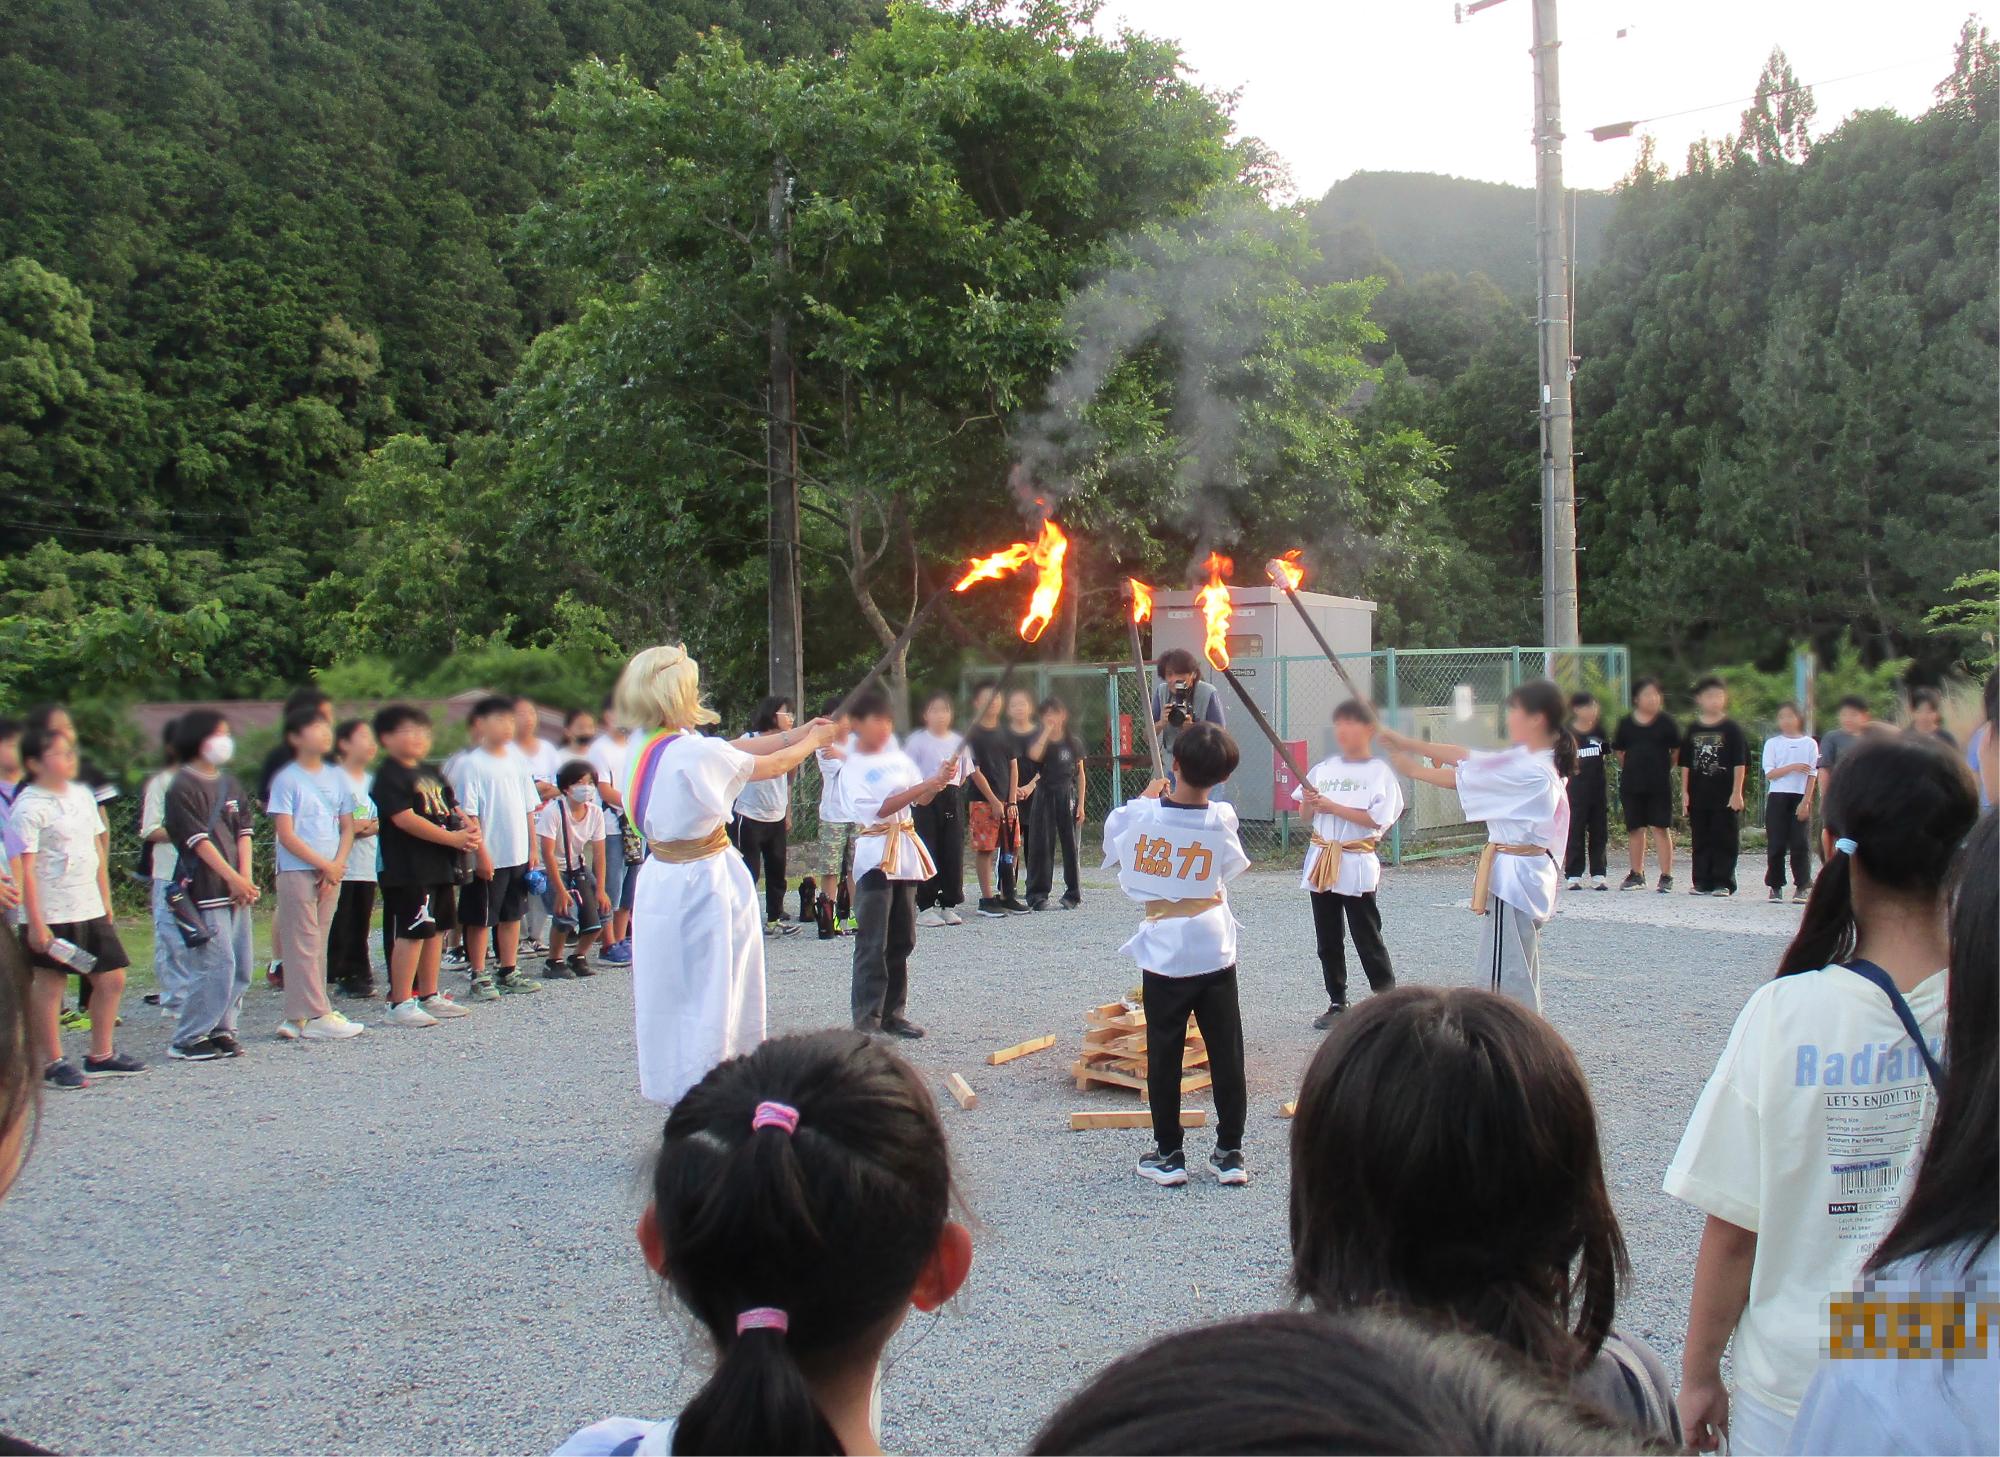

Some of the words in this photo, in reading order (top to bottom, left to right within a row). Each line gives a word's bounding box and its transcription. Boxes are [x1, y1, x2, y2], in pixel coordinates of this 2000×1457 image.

[1134, 834, 1213, 881] 協力
[1826, 1096, 1859, 1107] LET'S
[1864, 1091, 1900, 1108] ENJOY!
[1833, 1164, 1867, 1173] Nutrition
[1870, 1160, 1889, 1169] Facts
